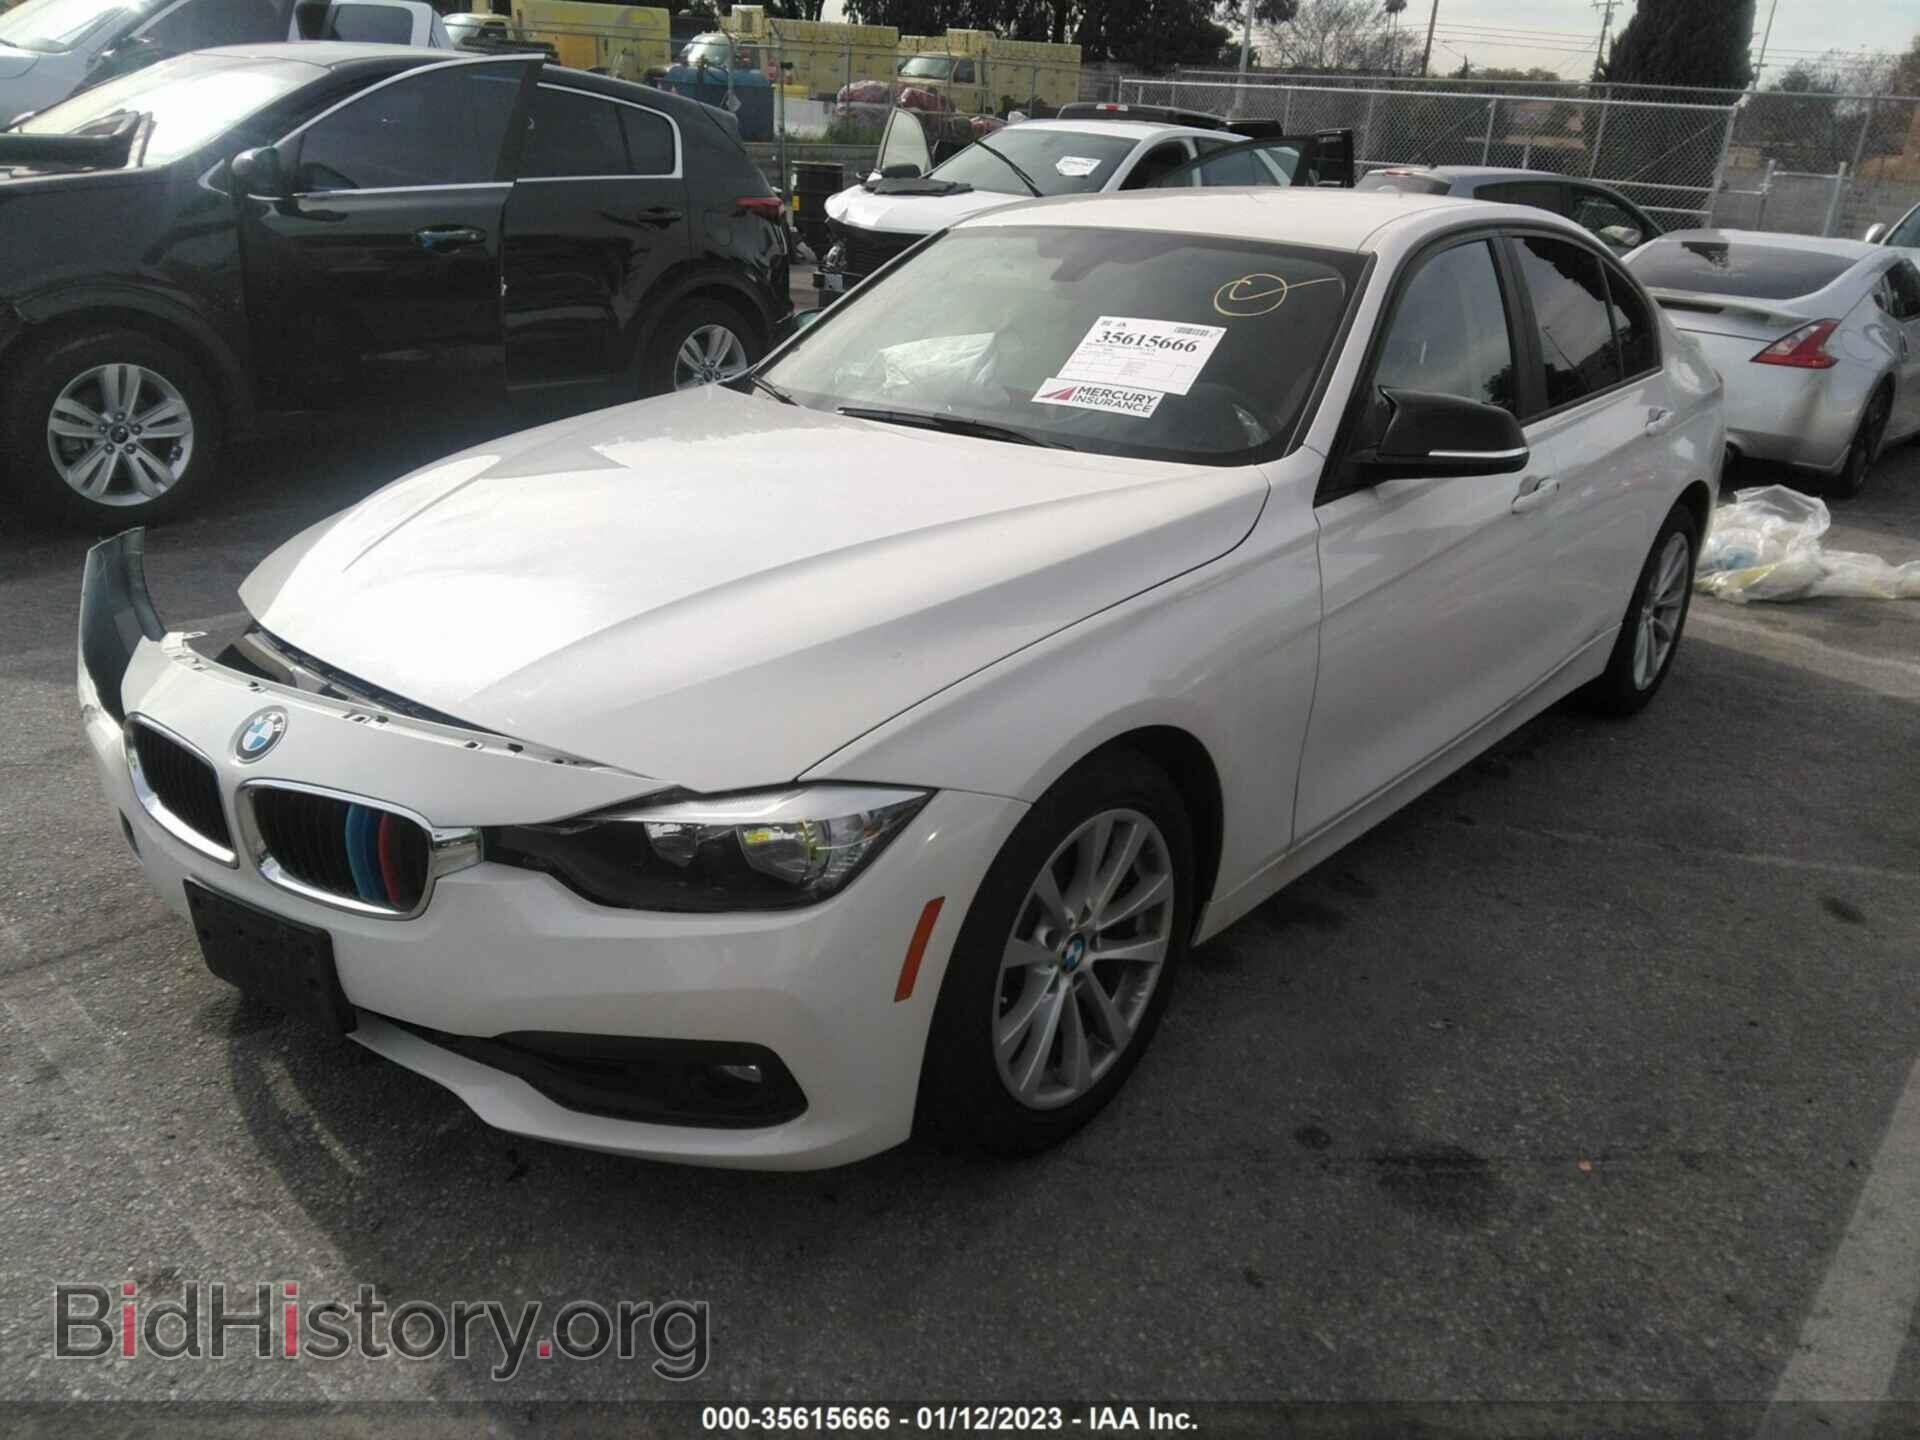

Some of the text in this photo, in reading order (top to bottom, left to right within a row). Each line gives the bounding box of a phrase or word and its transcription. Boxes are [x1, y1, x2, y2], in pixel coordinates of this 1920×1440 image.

[1096, 331, 1200, 353] 35615666
[1071, 395, 1153, 413] INSURANCE
[1076, 386, 1158, 405] MERCURY
